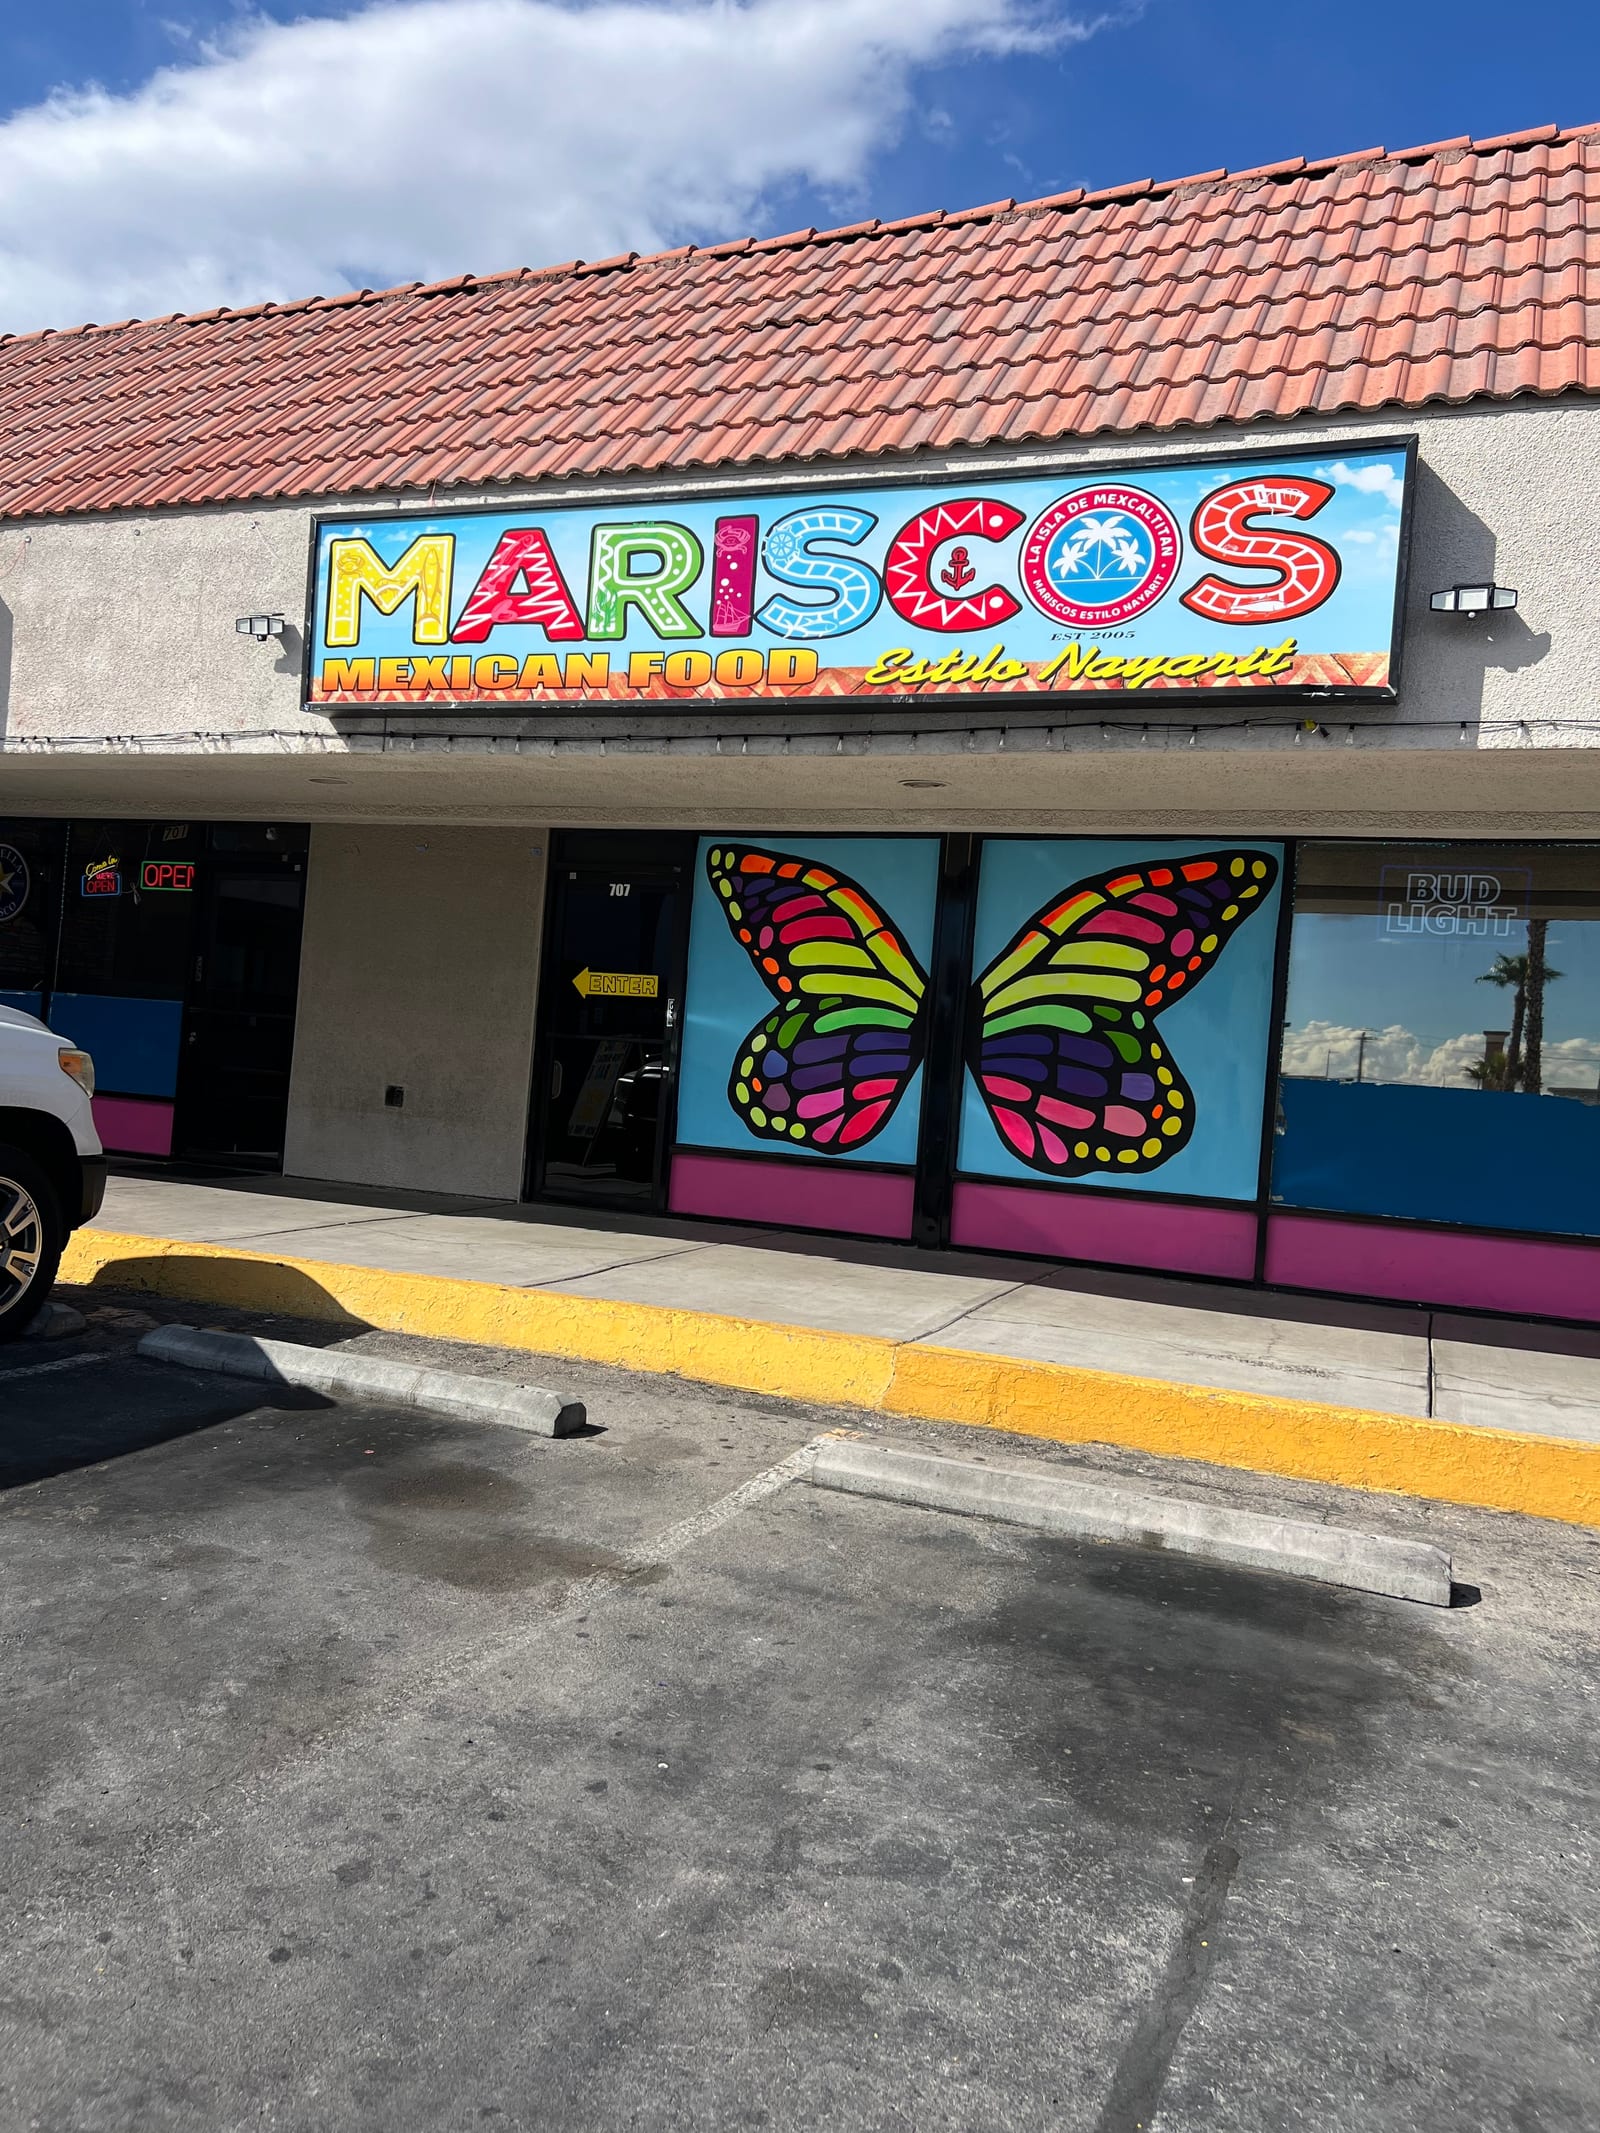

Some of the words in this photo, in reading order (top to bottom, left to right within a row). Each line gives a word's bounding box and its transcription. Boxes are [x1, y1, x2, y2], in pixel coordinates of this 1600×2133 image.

[1028, 545, 1042, 563] LA
[1036, 511, 1065, 541] ISLA
[1067, 498, 1088, 513] DE
[1093, 493, 1174, 557] MEXCALTITAN
[325, 475, 1342, 646] MARISCOS
[1033, 579, 1077, 617] MARISCOS
[1079, 607, 1121, 619] ESTILO
[1122, 573, 1165, 612] NAYARIT
[1050, 633, 1085, 641] EST
[1090, 631, 1136, 639] 2005
[322, 653, 609, 691] MEXICAN
[628, 648, 819, 687] FOOD
[864, 643, 1028, 686] Estilo
[1037, 637, 1298, 690] Nayarit
[86, 879, 116, 894] OPEN
[609, 883, 631, 897] 707
[1406, 873, 1501, 905] BUD
[1386, 903, 1518, 937] LIGHT
[589, 974, 656, 995] ENTER
